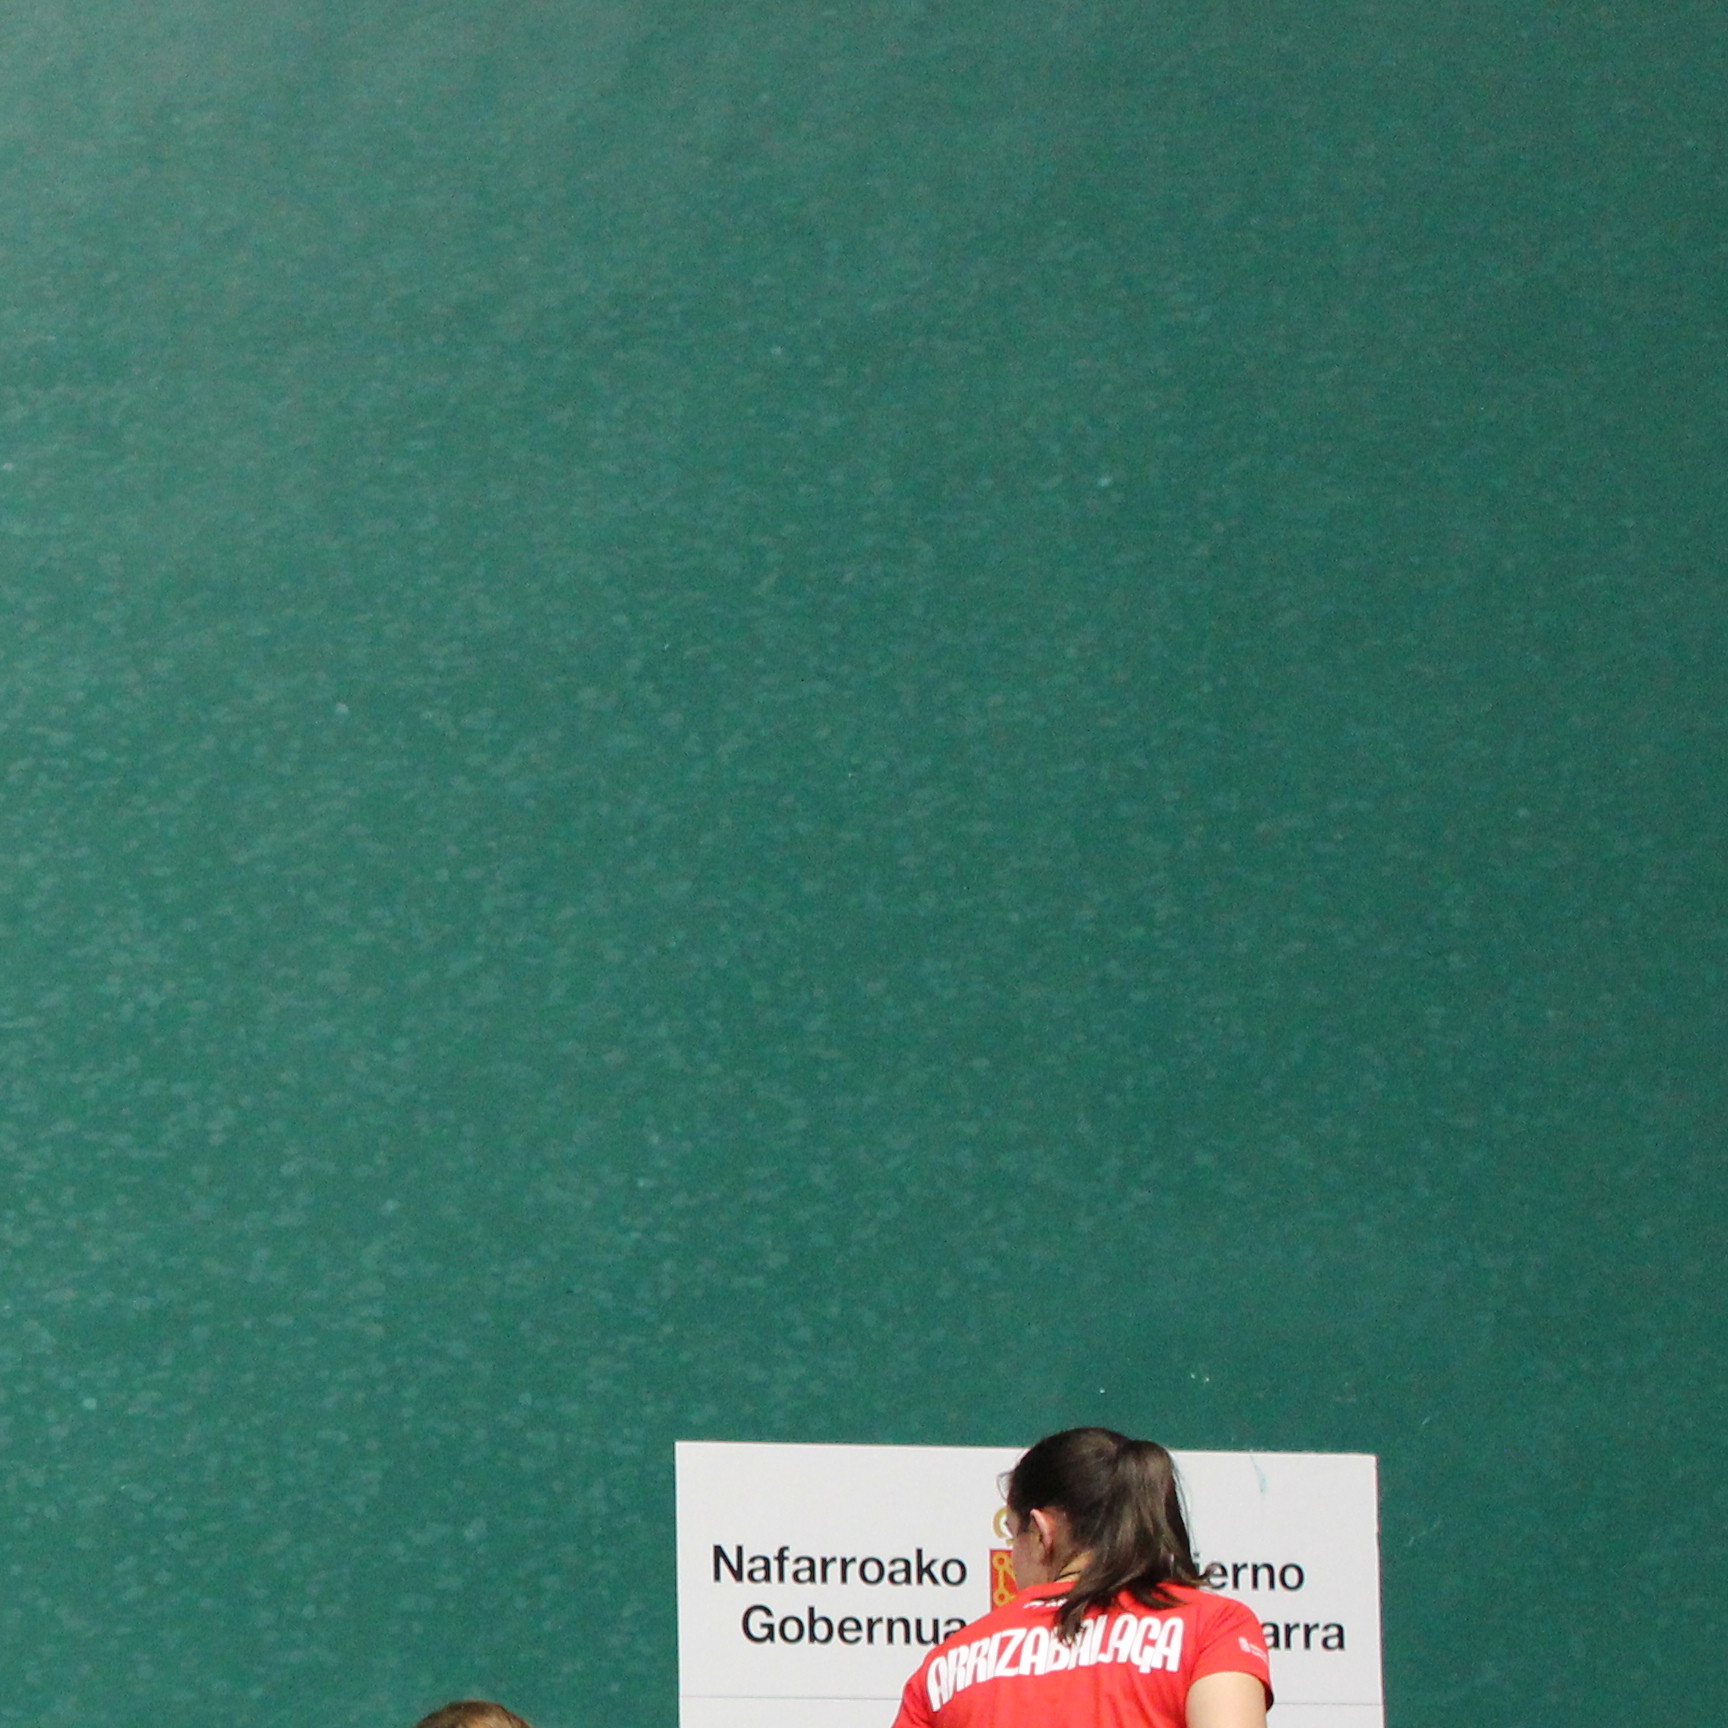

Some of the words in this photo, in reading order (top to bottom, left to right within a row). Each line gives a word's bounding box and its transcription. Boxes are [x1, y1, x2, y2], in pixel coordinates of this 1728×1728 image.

[713, 1545, 967, 1586] Nafarroako
[742, 1605, 966, 1645] Gobernua
[1261, 1622, 1345, 1650] arra
